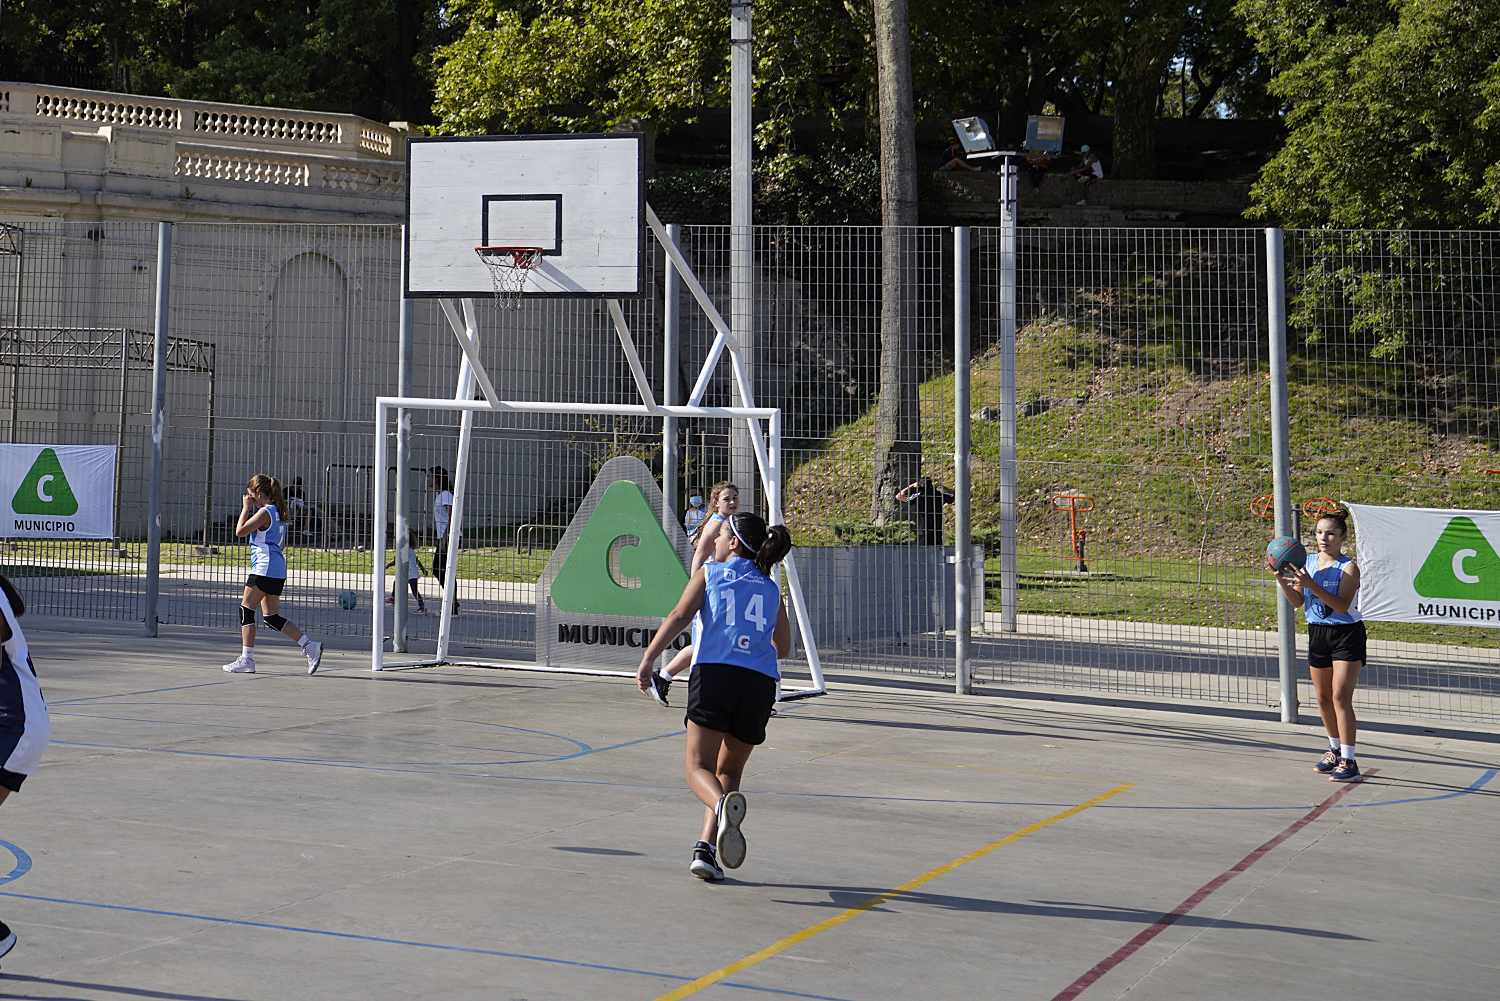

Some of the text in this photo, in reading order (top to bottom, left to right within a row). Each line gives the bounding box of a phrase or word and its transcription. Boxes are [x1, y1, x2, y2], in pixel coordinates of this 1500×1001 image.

[37, 474, 54, 502] C
[14, 520, 75, 532] MUNICIPIO
[606, 534, 641, 589] C
[1452, 549, 1480, 584] C
[720, 588, 767, 632] 14
